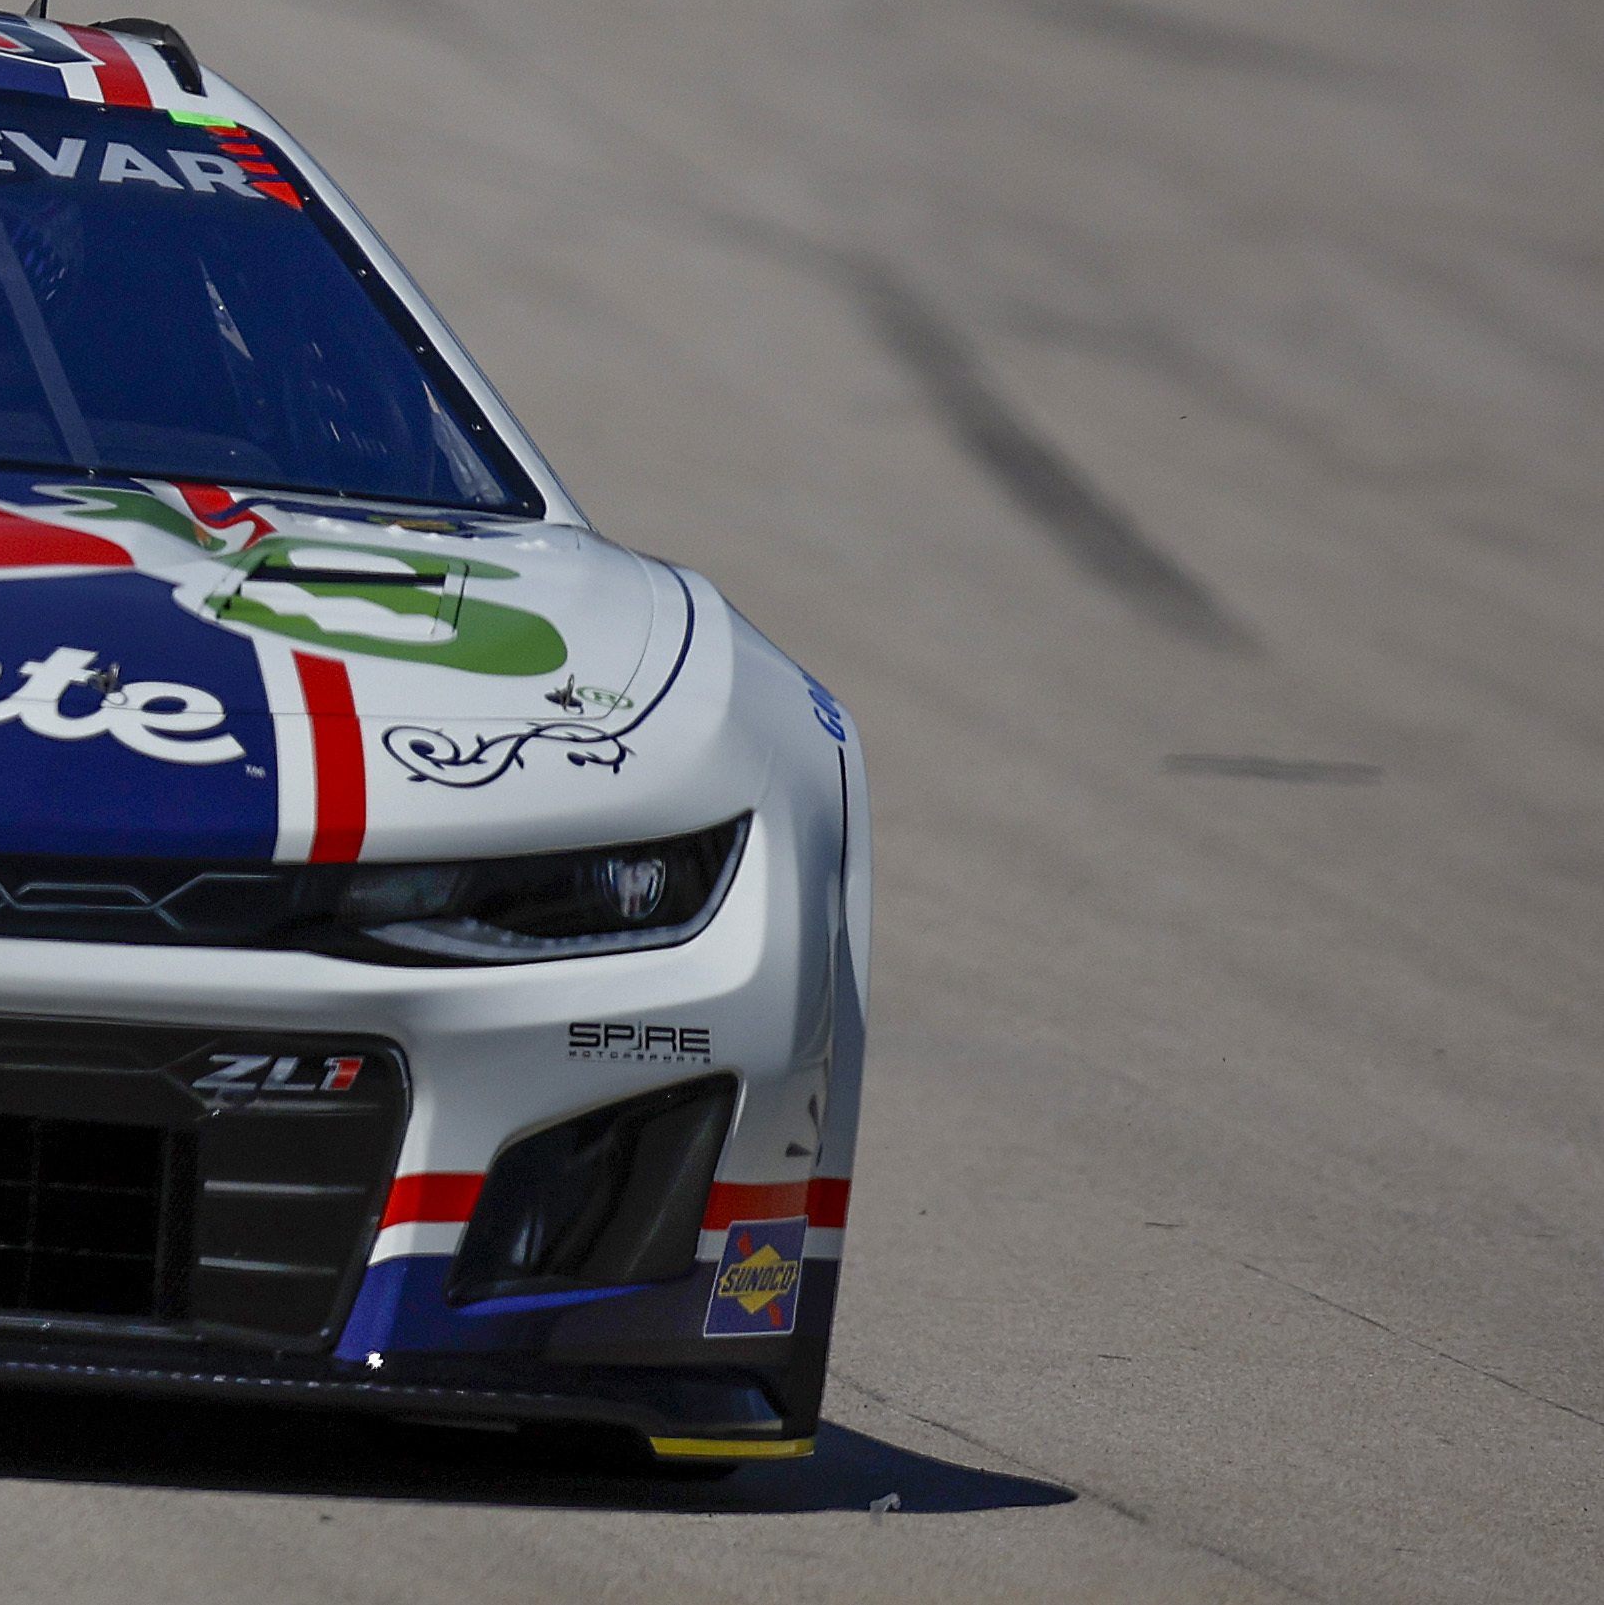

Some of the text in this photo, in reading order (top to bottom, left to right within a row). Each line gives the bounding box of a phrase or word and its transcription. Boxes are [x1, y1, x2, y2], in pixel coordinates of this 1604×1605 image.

[568, 1020, 711, 1054] SPIRE
[192, 1053, 364, 1092] ZL1
[720, 1263, 797, 1293] SUNOCO
